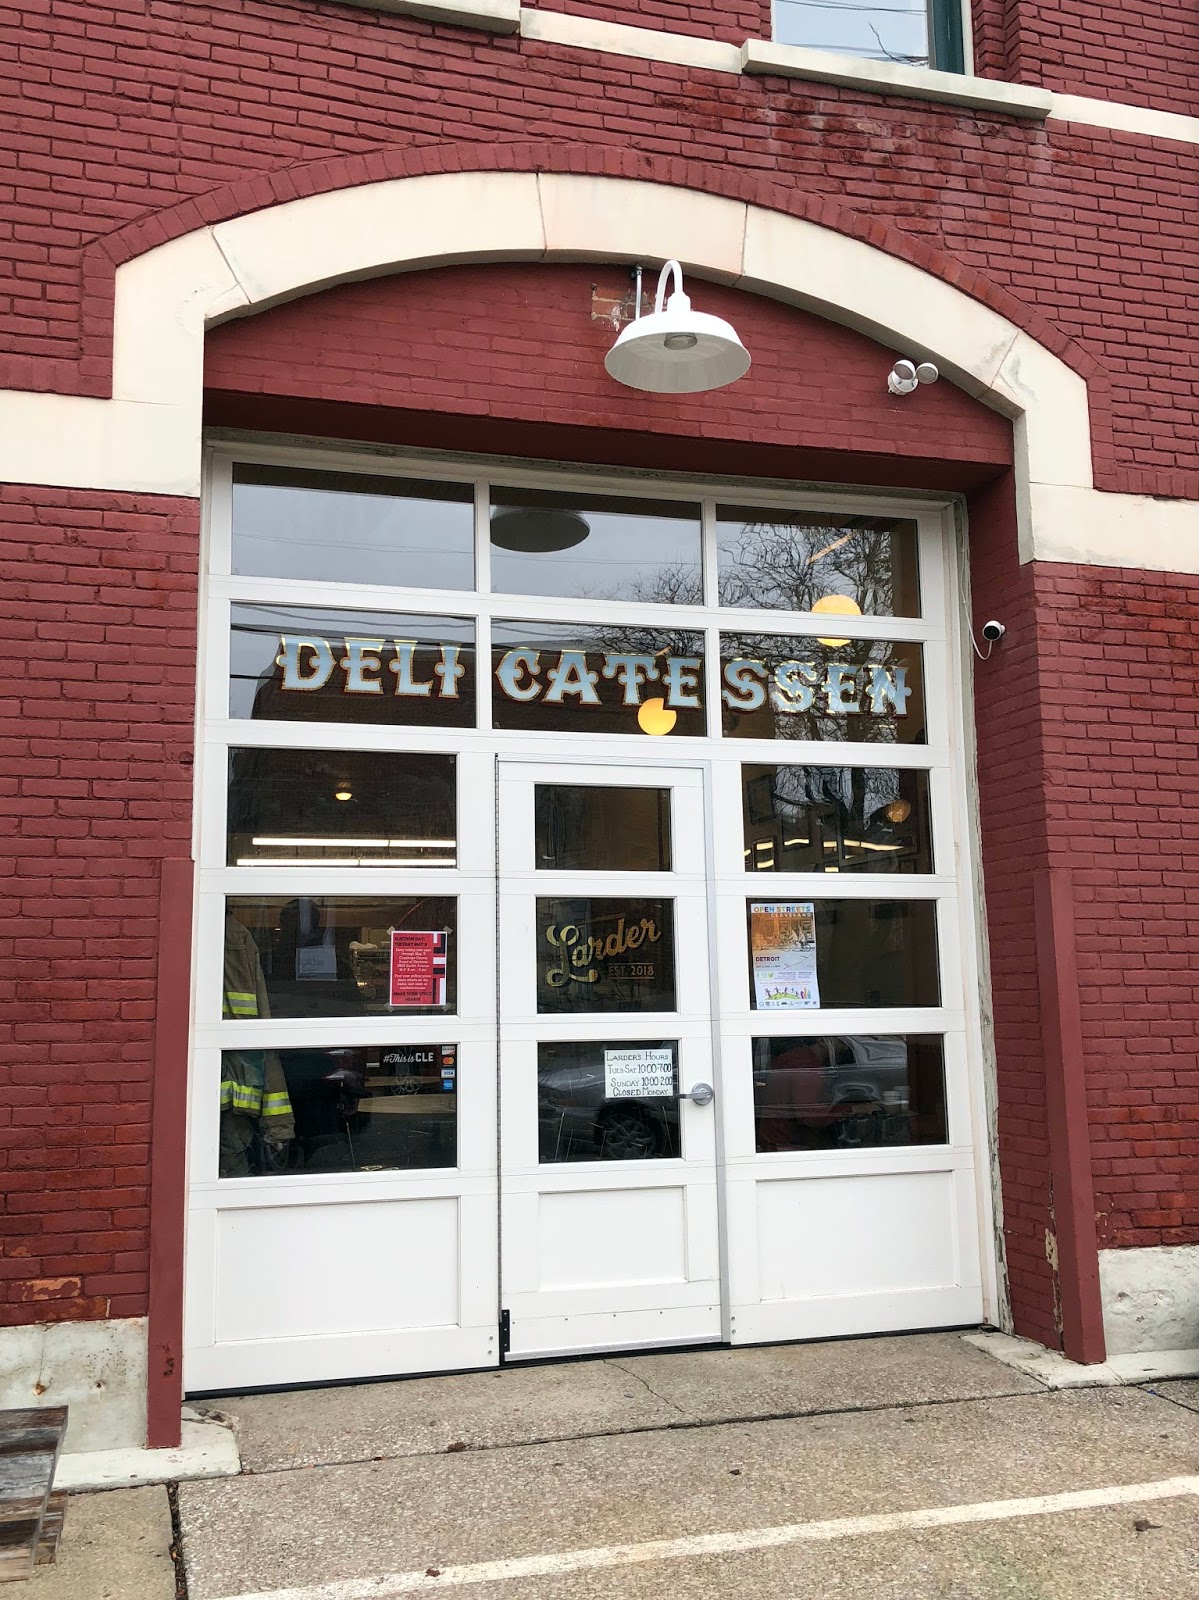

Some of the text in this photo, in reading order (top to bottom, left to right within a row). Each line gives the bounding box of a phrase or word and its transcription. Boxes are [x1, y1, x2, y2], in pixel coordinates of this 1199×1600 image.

[275, 633, 913, 717] DELICATESSEN
[546, 917, 662, 986] Larder
[631, 966, 654, 976] 2018
